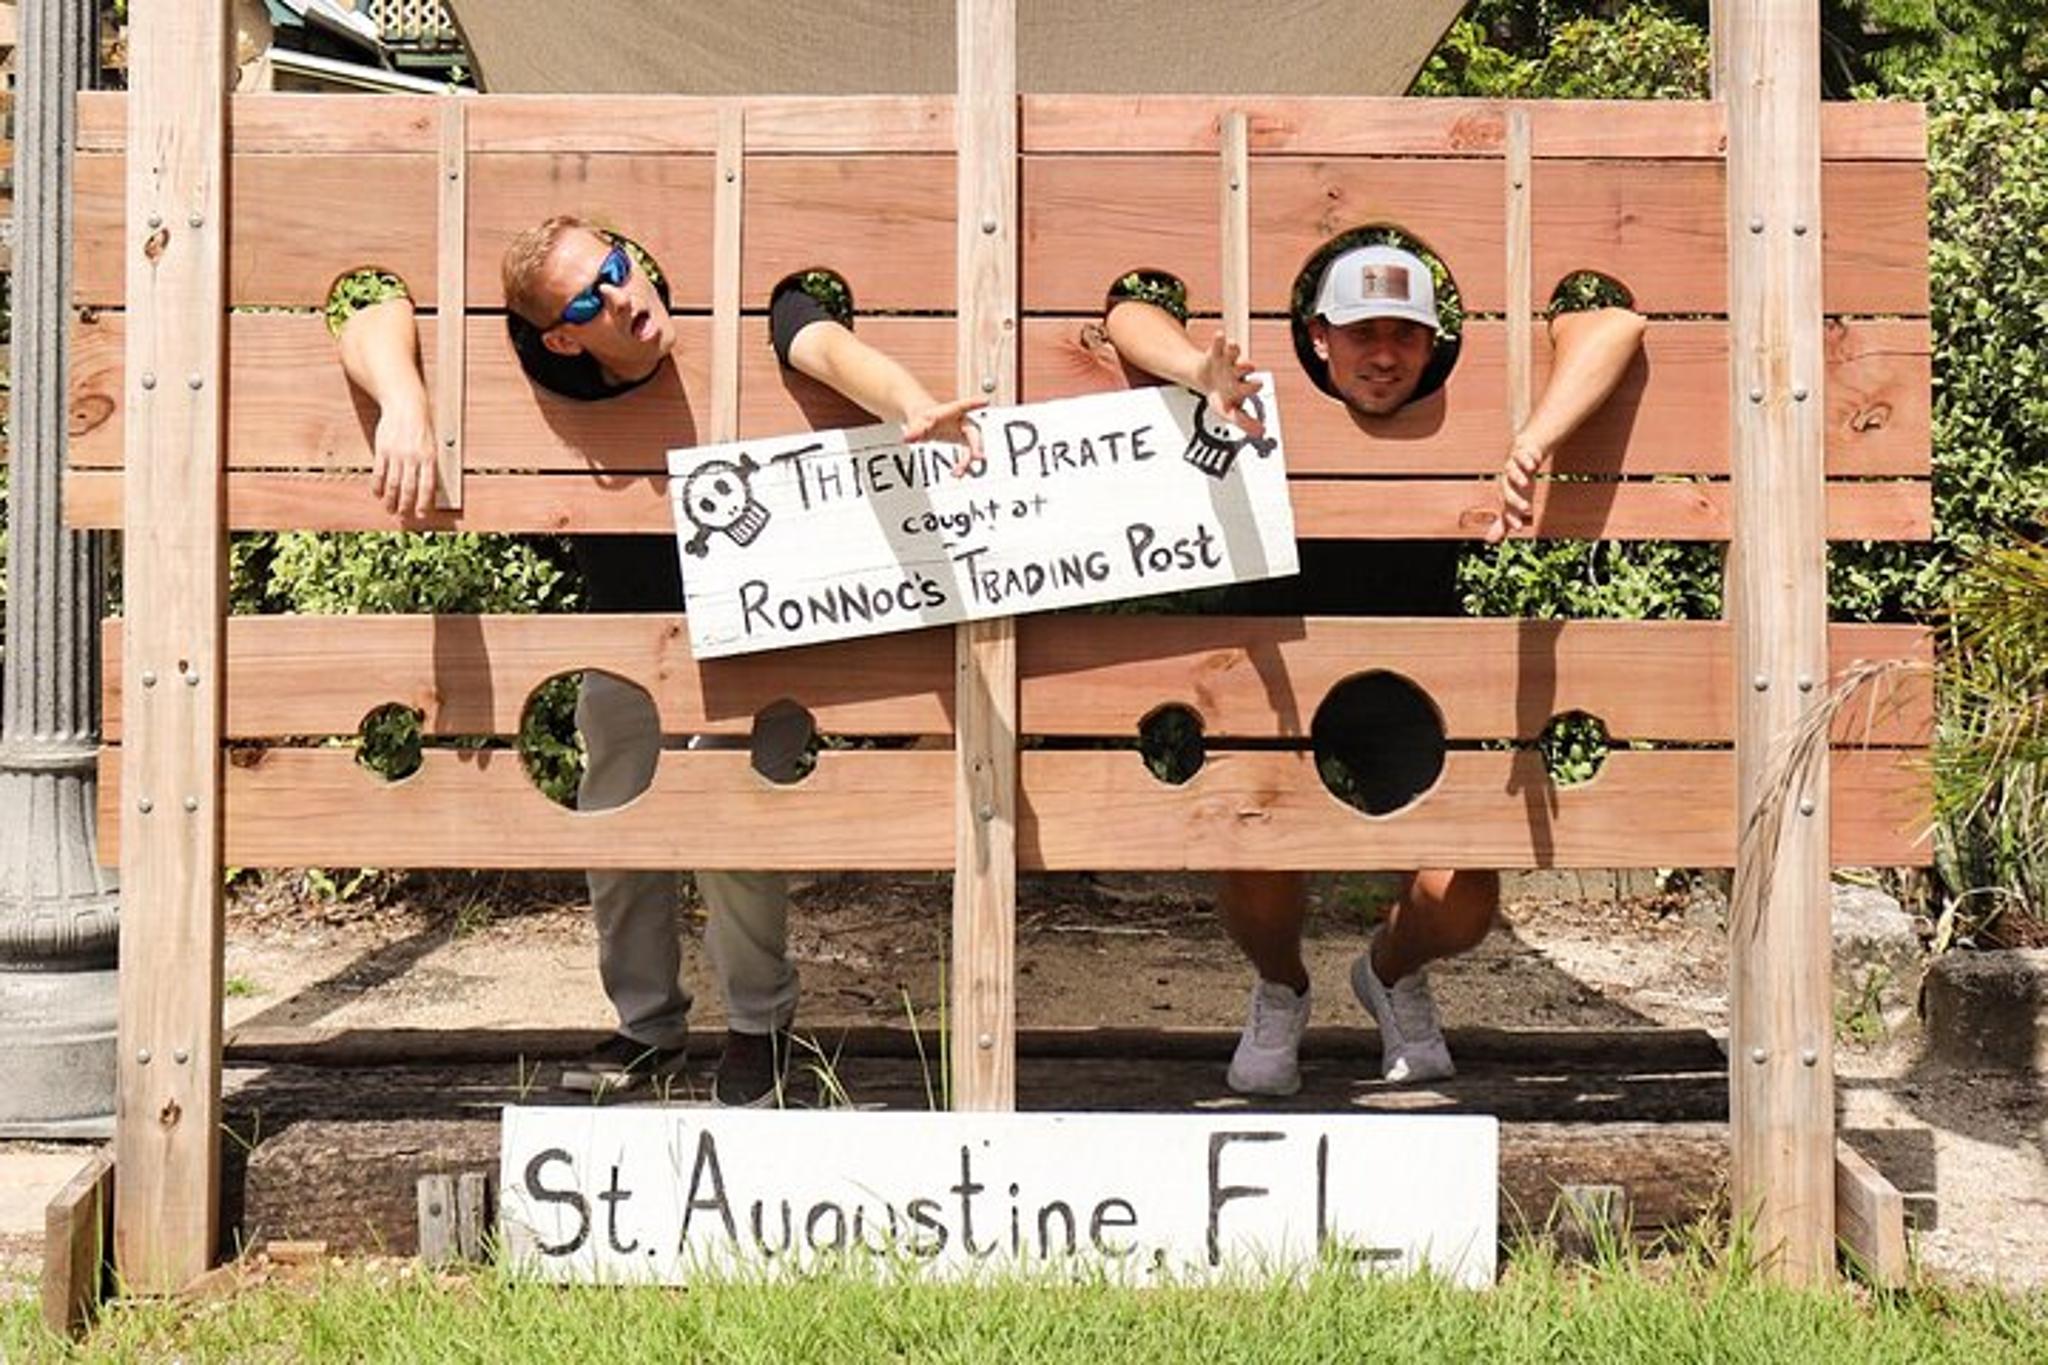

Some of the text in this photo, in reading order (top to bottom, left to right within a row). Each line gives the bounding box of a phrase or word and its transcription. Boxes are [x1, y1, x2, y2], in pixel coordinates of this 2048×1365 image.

[1004, 420, 1157, 478] PIRATE
[902, 494, 1048, 538] caught at
[953, 546, 1110, 604] TRADING
[524, 1148, 656, 1257] St.
[1206, 1131, 1403, 1266] FL
